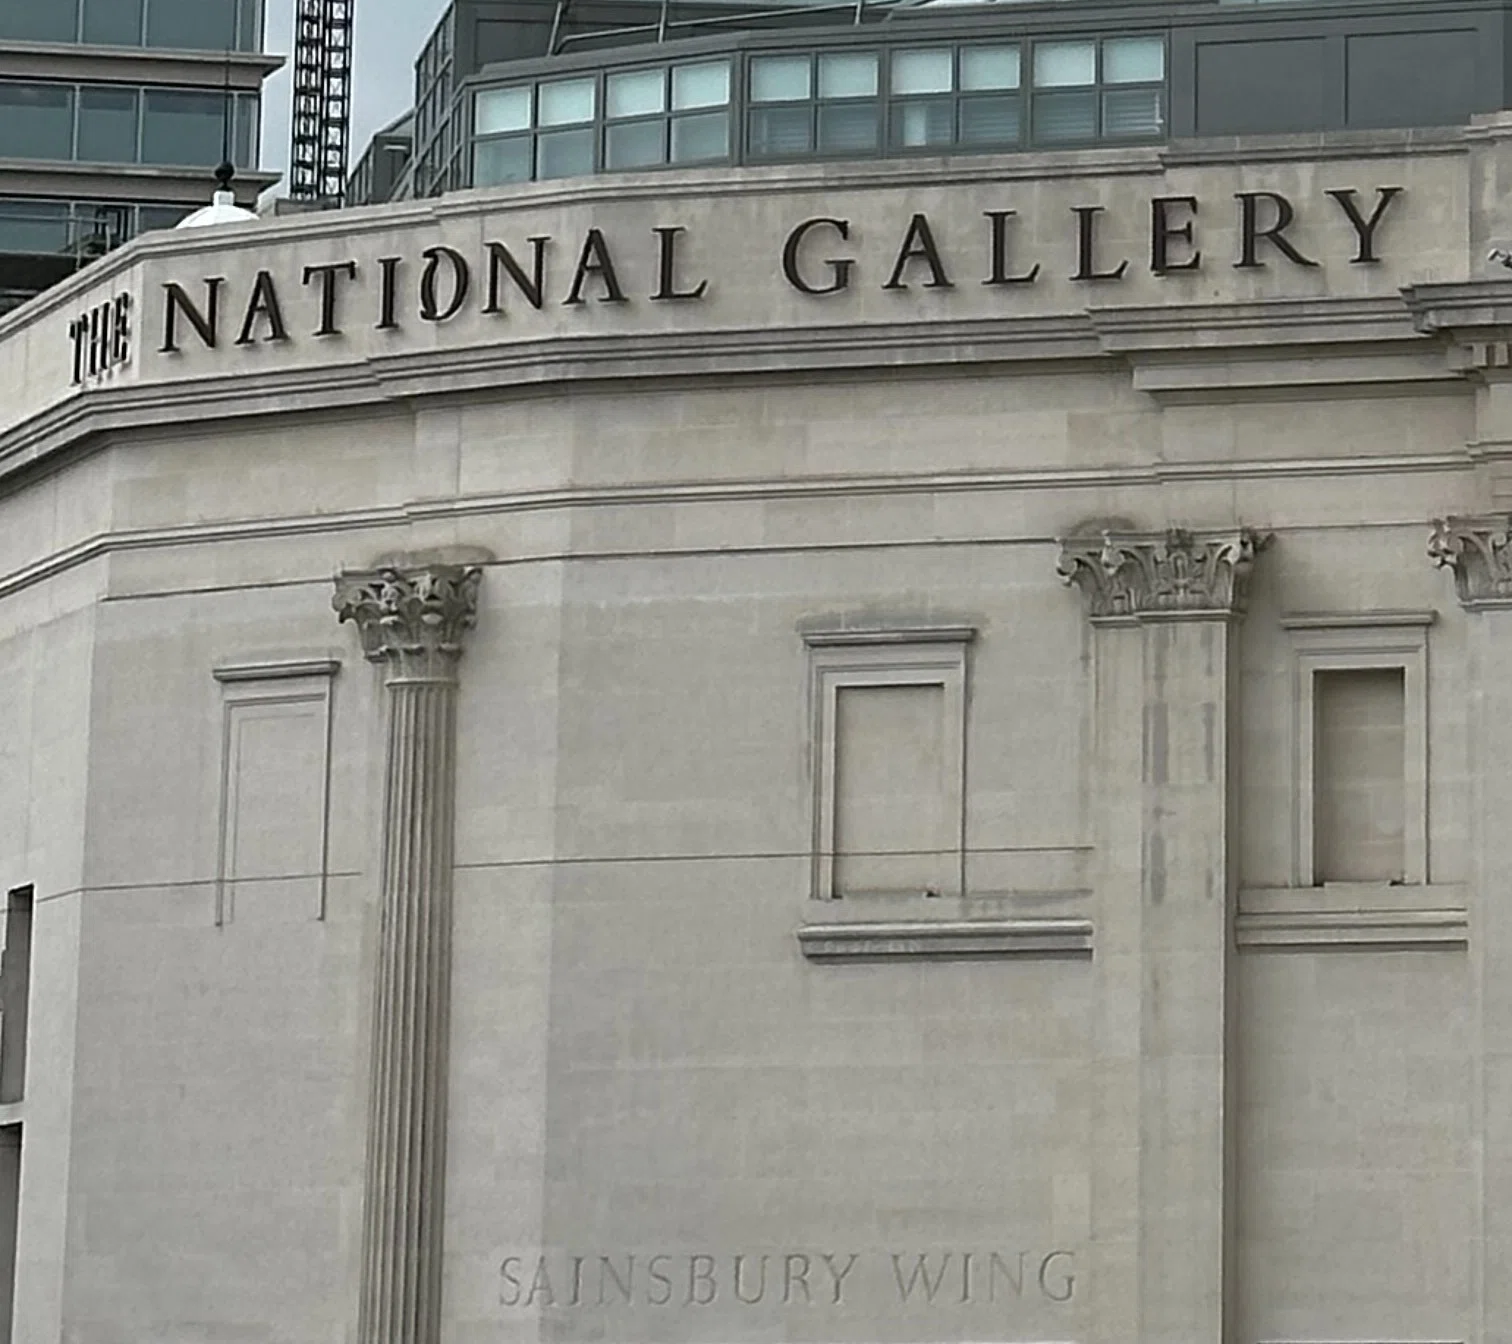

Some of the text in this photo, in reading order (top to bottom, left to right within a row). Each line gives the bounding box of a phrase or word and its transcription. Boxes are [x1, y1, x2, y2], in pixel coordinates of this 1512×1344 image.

[69, 187, 1403, 386] THE NATIONAL GALLERY
[500, 1250, 1077, 1306] SAINSBURY WING
